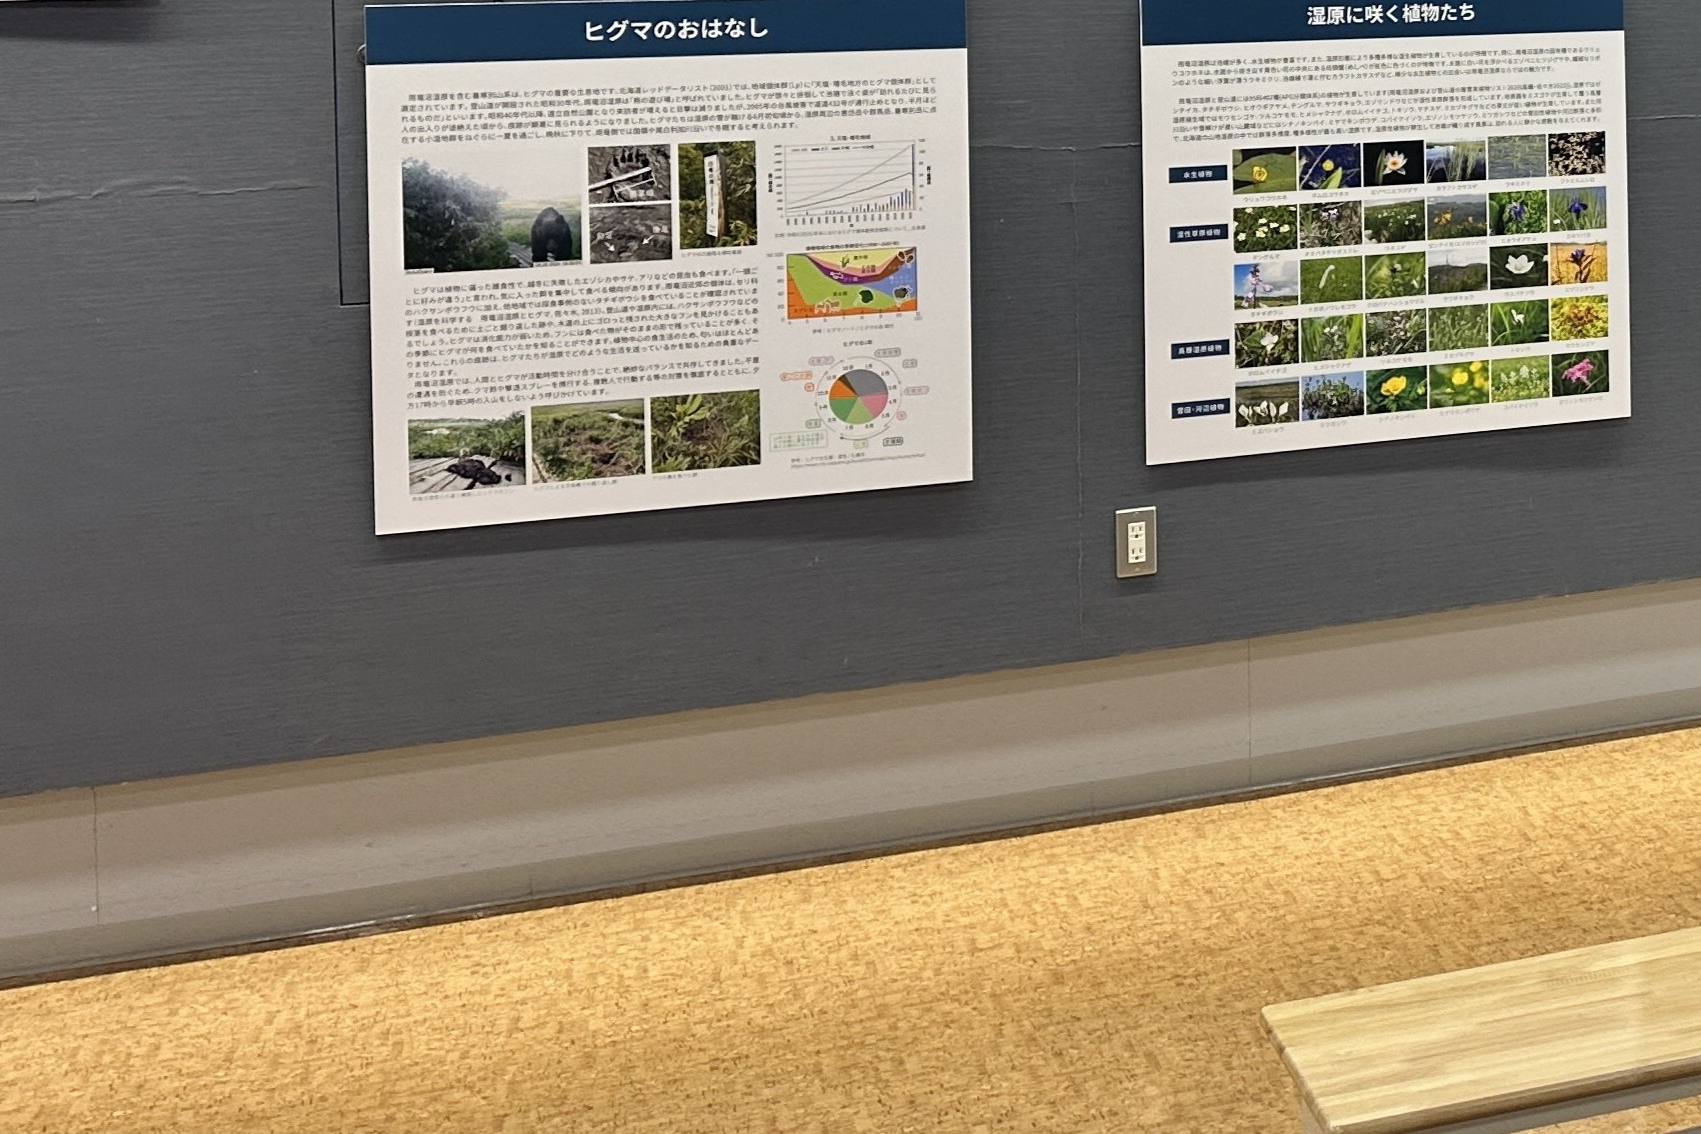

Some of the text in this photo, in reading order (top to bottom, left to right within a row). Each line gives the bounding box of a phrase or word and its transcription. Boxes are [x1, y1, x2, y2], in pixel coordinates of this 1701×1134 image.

[1306, 1, 1475, 27] 湿原に咲く植物たち
[585, 17, 769, 42] ヒグマのおはなし
